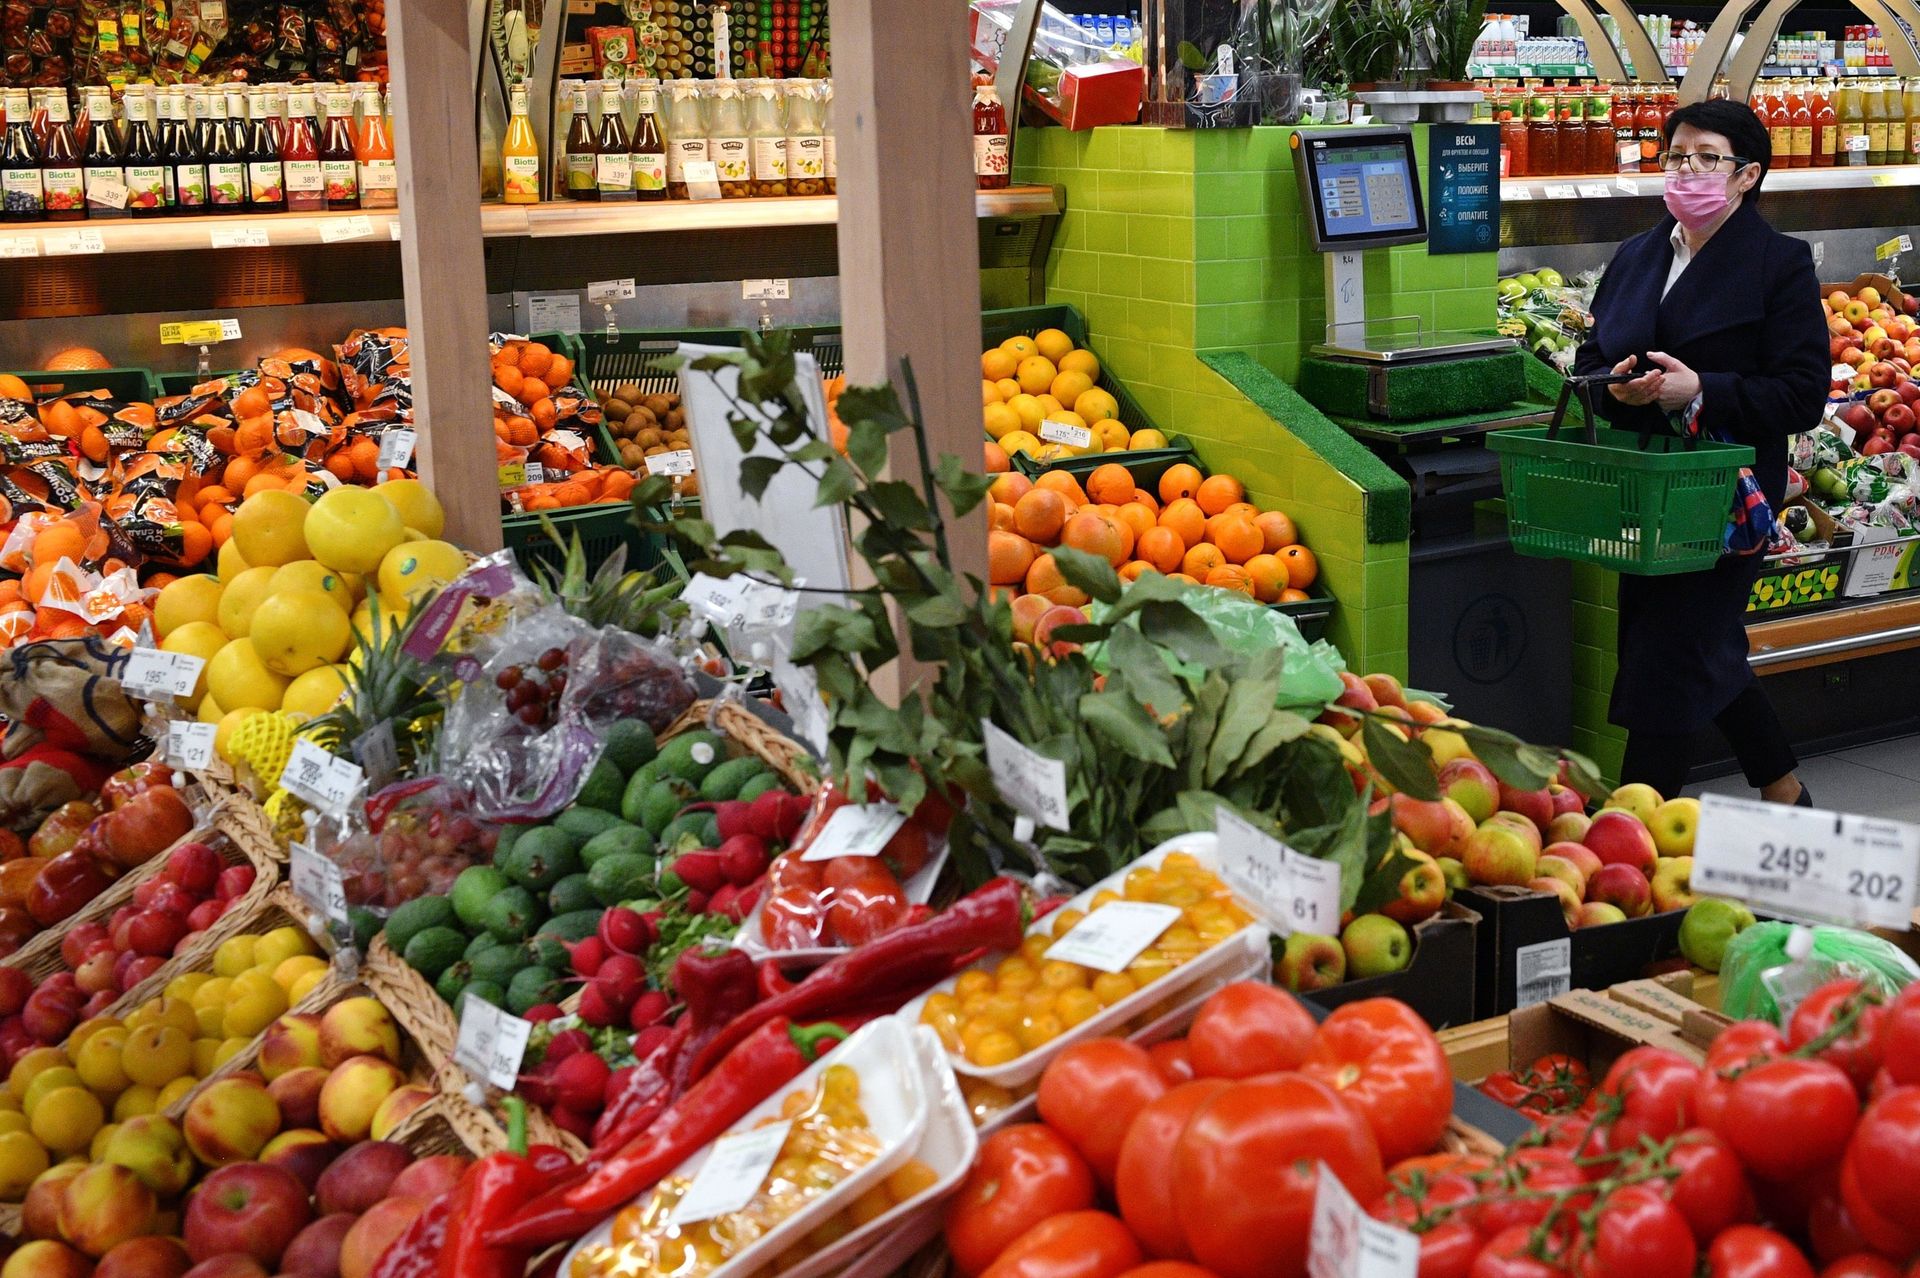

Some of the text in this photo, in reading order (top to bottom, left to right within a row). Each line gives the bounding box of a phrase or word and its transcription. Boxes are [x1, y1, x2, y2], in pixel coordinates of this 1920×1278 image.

[1456, 136, 1476, 146] ВЕСЫ
[1458, 162, 1488, 172] ВЫБЕРИТЕ
[9, 171, 36, 180] Biotta
[48, 170, 76, 179] Biotta
[90, 169, 117, 178] Biotta
[133, 168, 159, 177] Biotta
[1458, 185, 1488, 195] ПОЛОЖИТЕ
[1458, 210, 1488, 220] ОПЛАТИТЕ
[1874, 546, 1895, 556] PDM
[175, 681, 186, 692] 19
[187, 748, 204, 761] 121
[1760, 842, 1810, 876] 249
[1848, 870, 1902, 900] 202
[1294, 898, 1317, 921] 61
